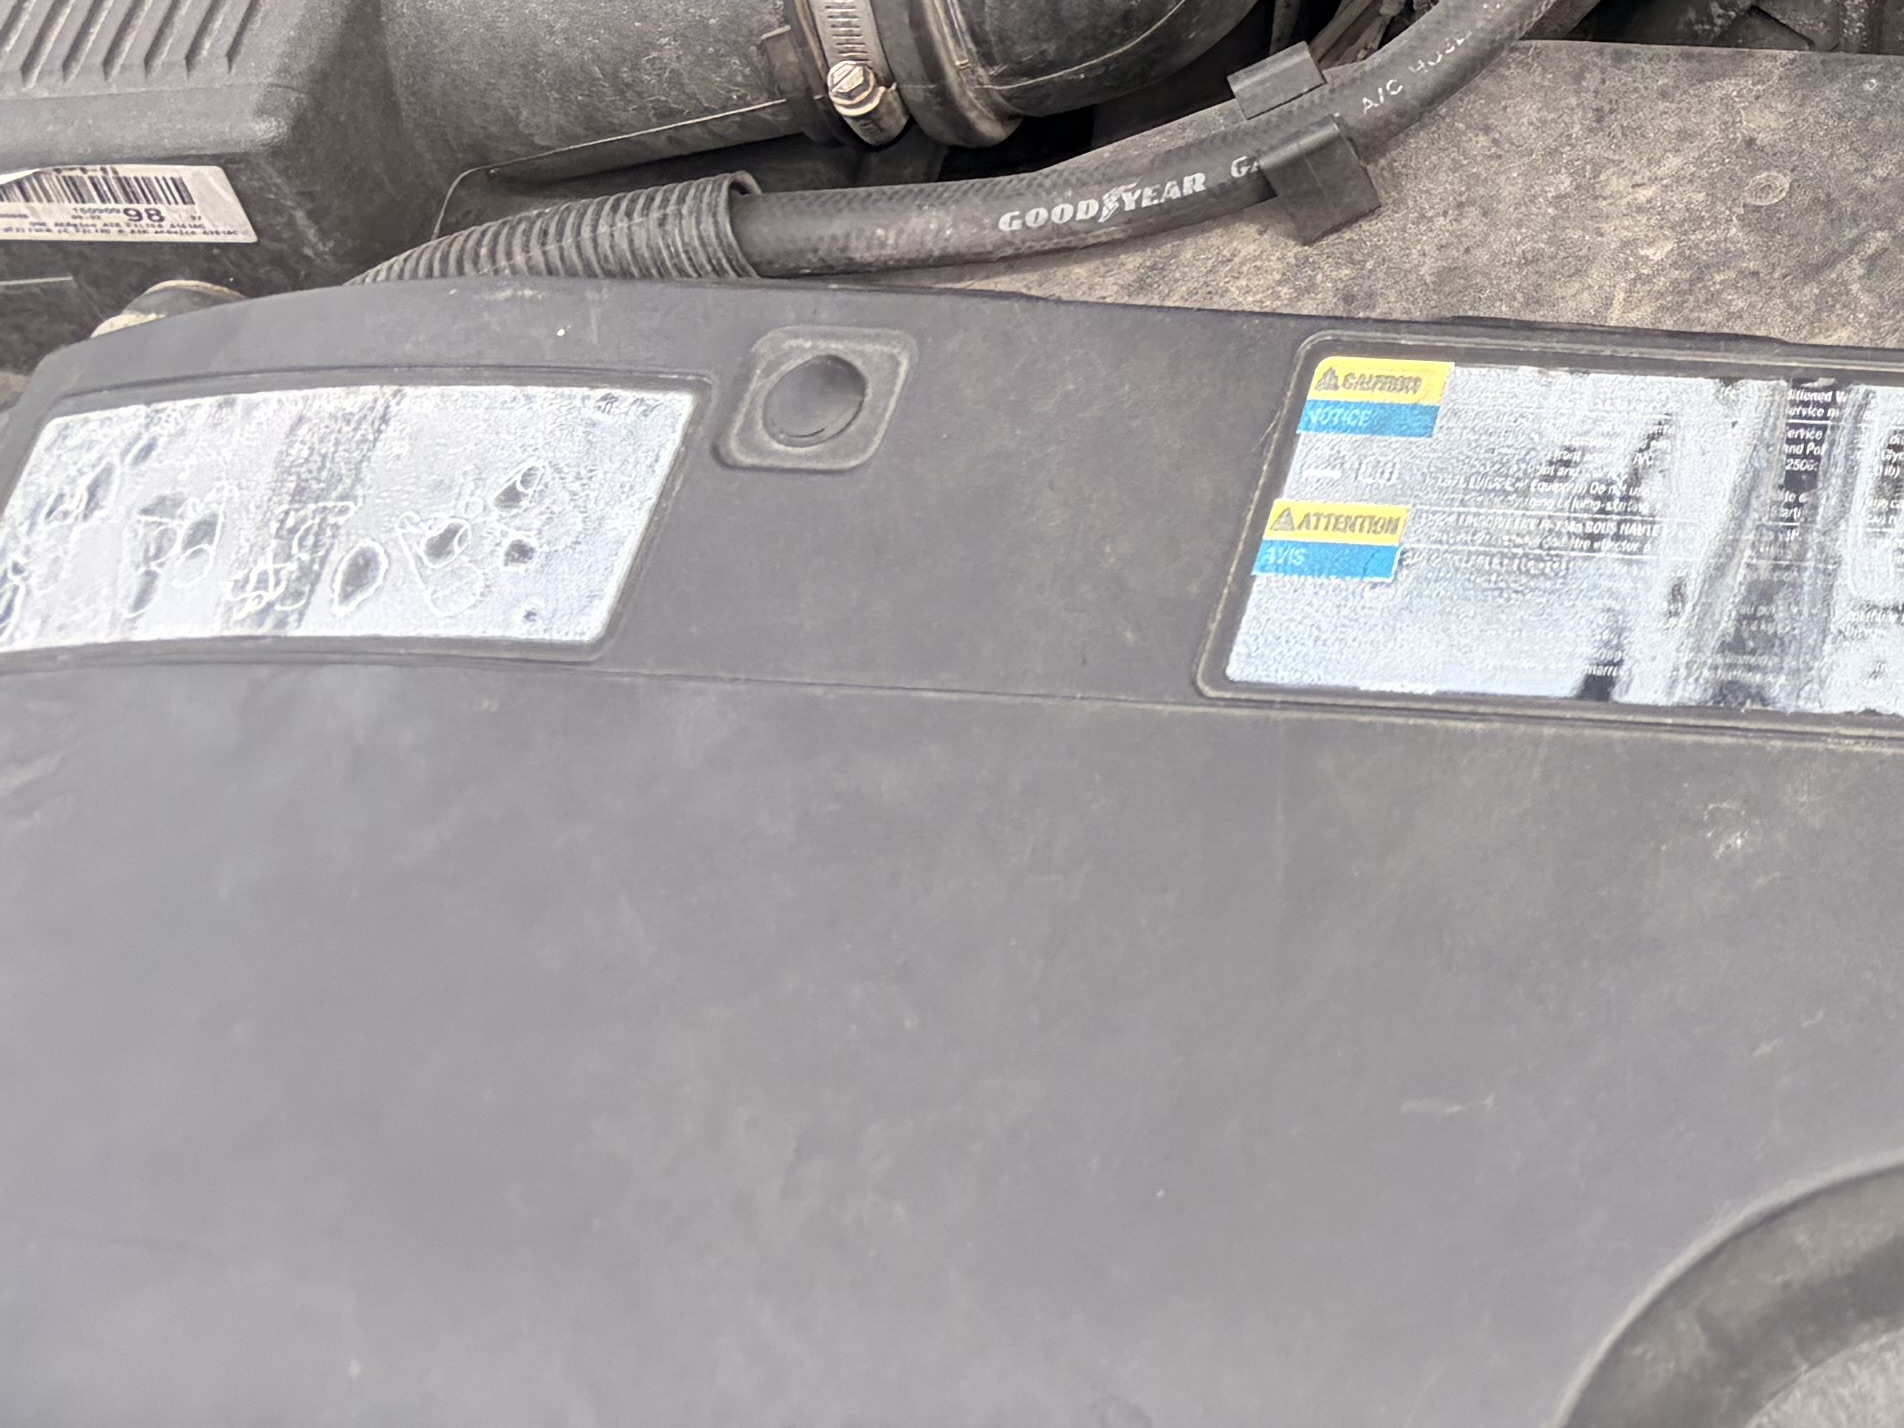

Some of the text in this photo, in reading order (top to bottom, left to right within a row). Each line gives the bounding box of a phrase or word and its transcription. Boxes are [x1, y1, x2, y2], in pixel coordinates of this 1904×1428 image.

[998, 173, 1207, 233] GOODYEAR
[122, 207, 166, 224] 98
[1340, 372, 1423, 396] CAUTION
[1307, 407, 1374, 429] NOTICE
[1297, 512, 1403, 534] ATTENTION
[1261, 545, 1308, 568] AVIS
